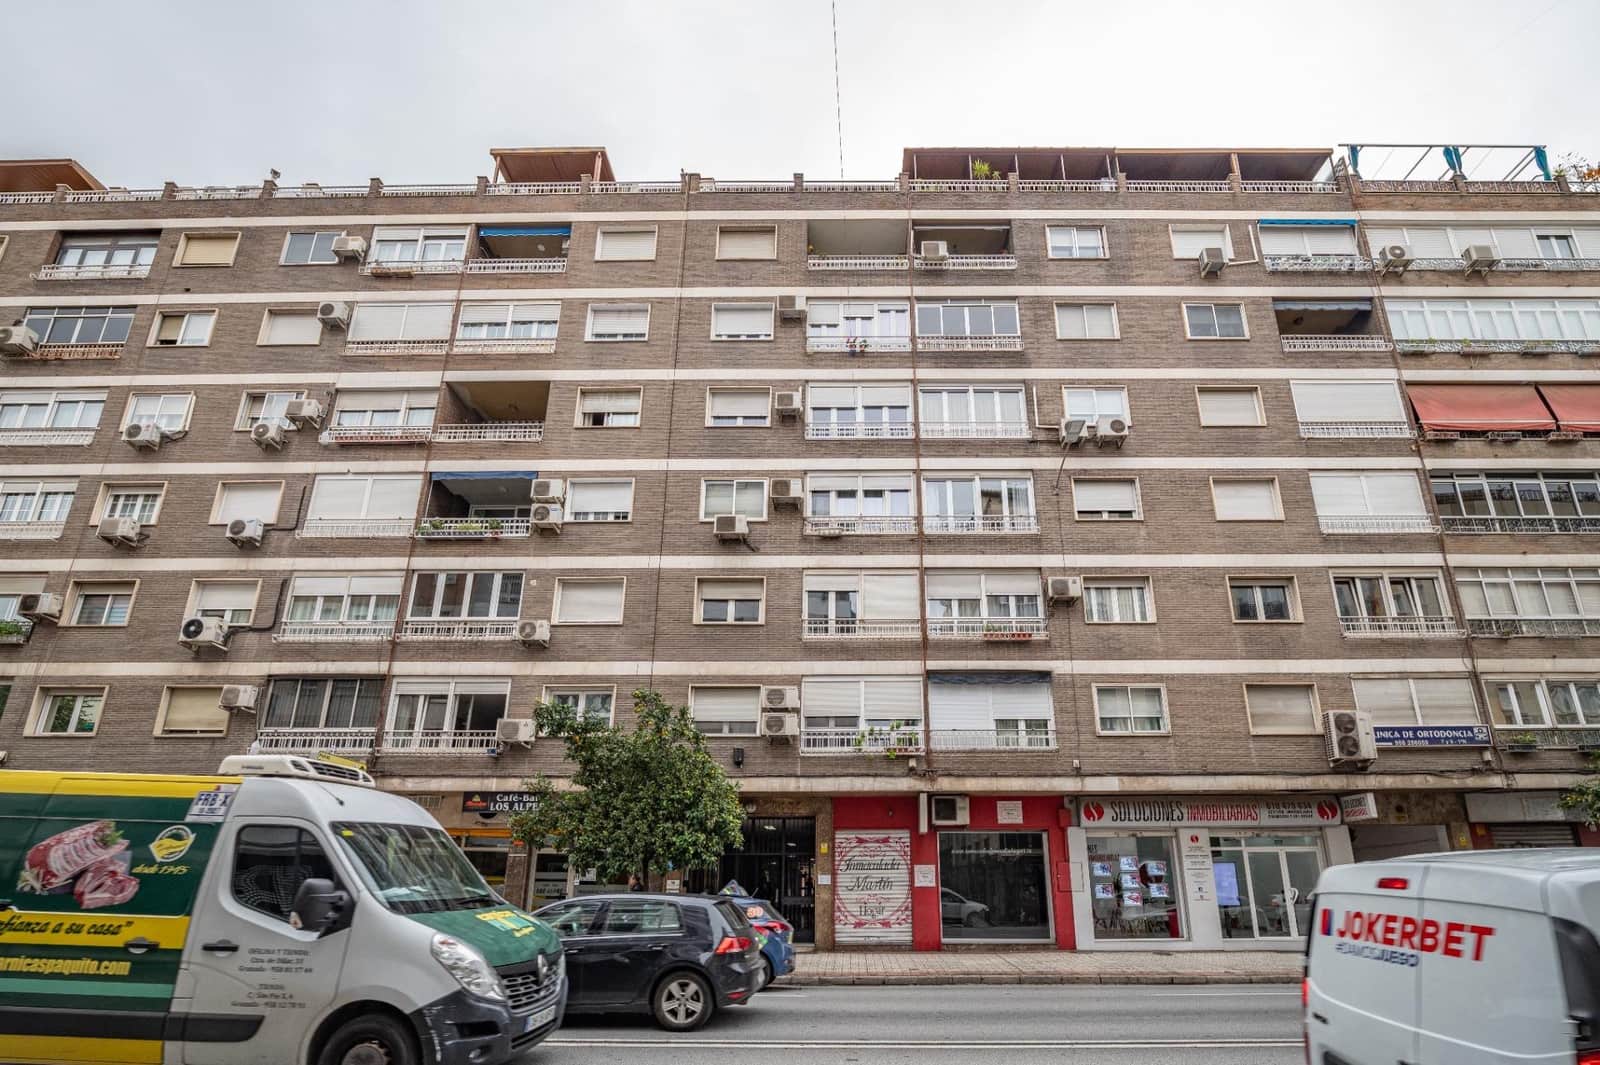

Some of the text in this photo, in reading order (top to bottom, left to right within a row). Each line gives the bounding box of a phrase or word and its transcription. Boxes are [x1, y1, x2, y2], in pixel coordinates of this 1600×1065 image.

[1417, 729, 1473, 738] ORTODONCIA
[489, 802, 509, 811] LOS
[1111, 800, 1259, 822] SOLUCIONES INMOBILIARIAS
[65, 922, 85, 935] su
[1337, 910, 1497, 962] JOKERBET
